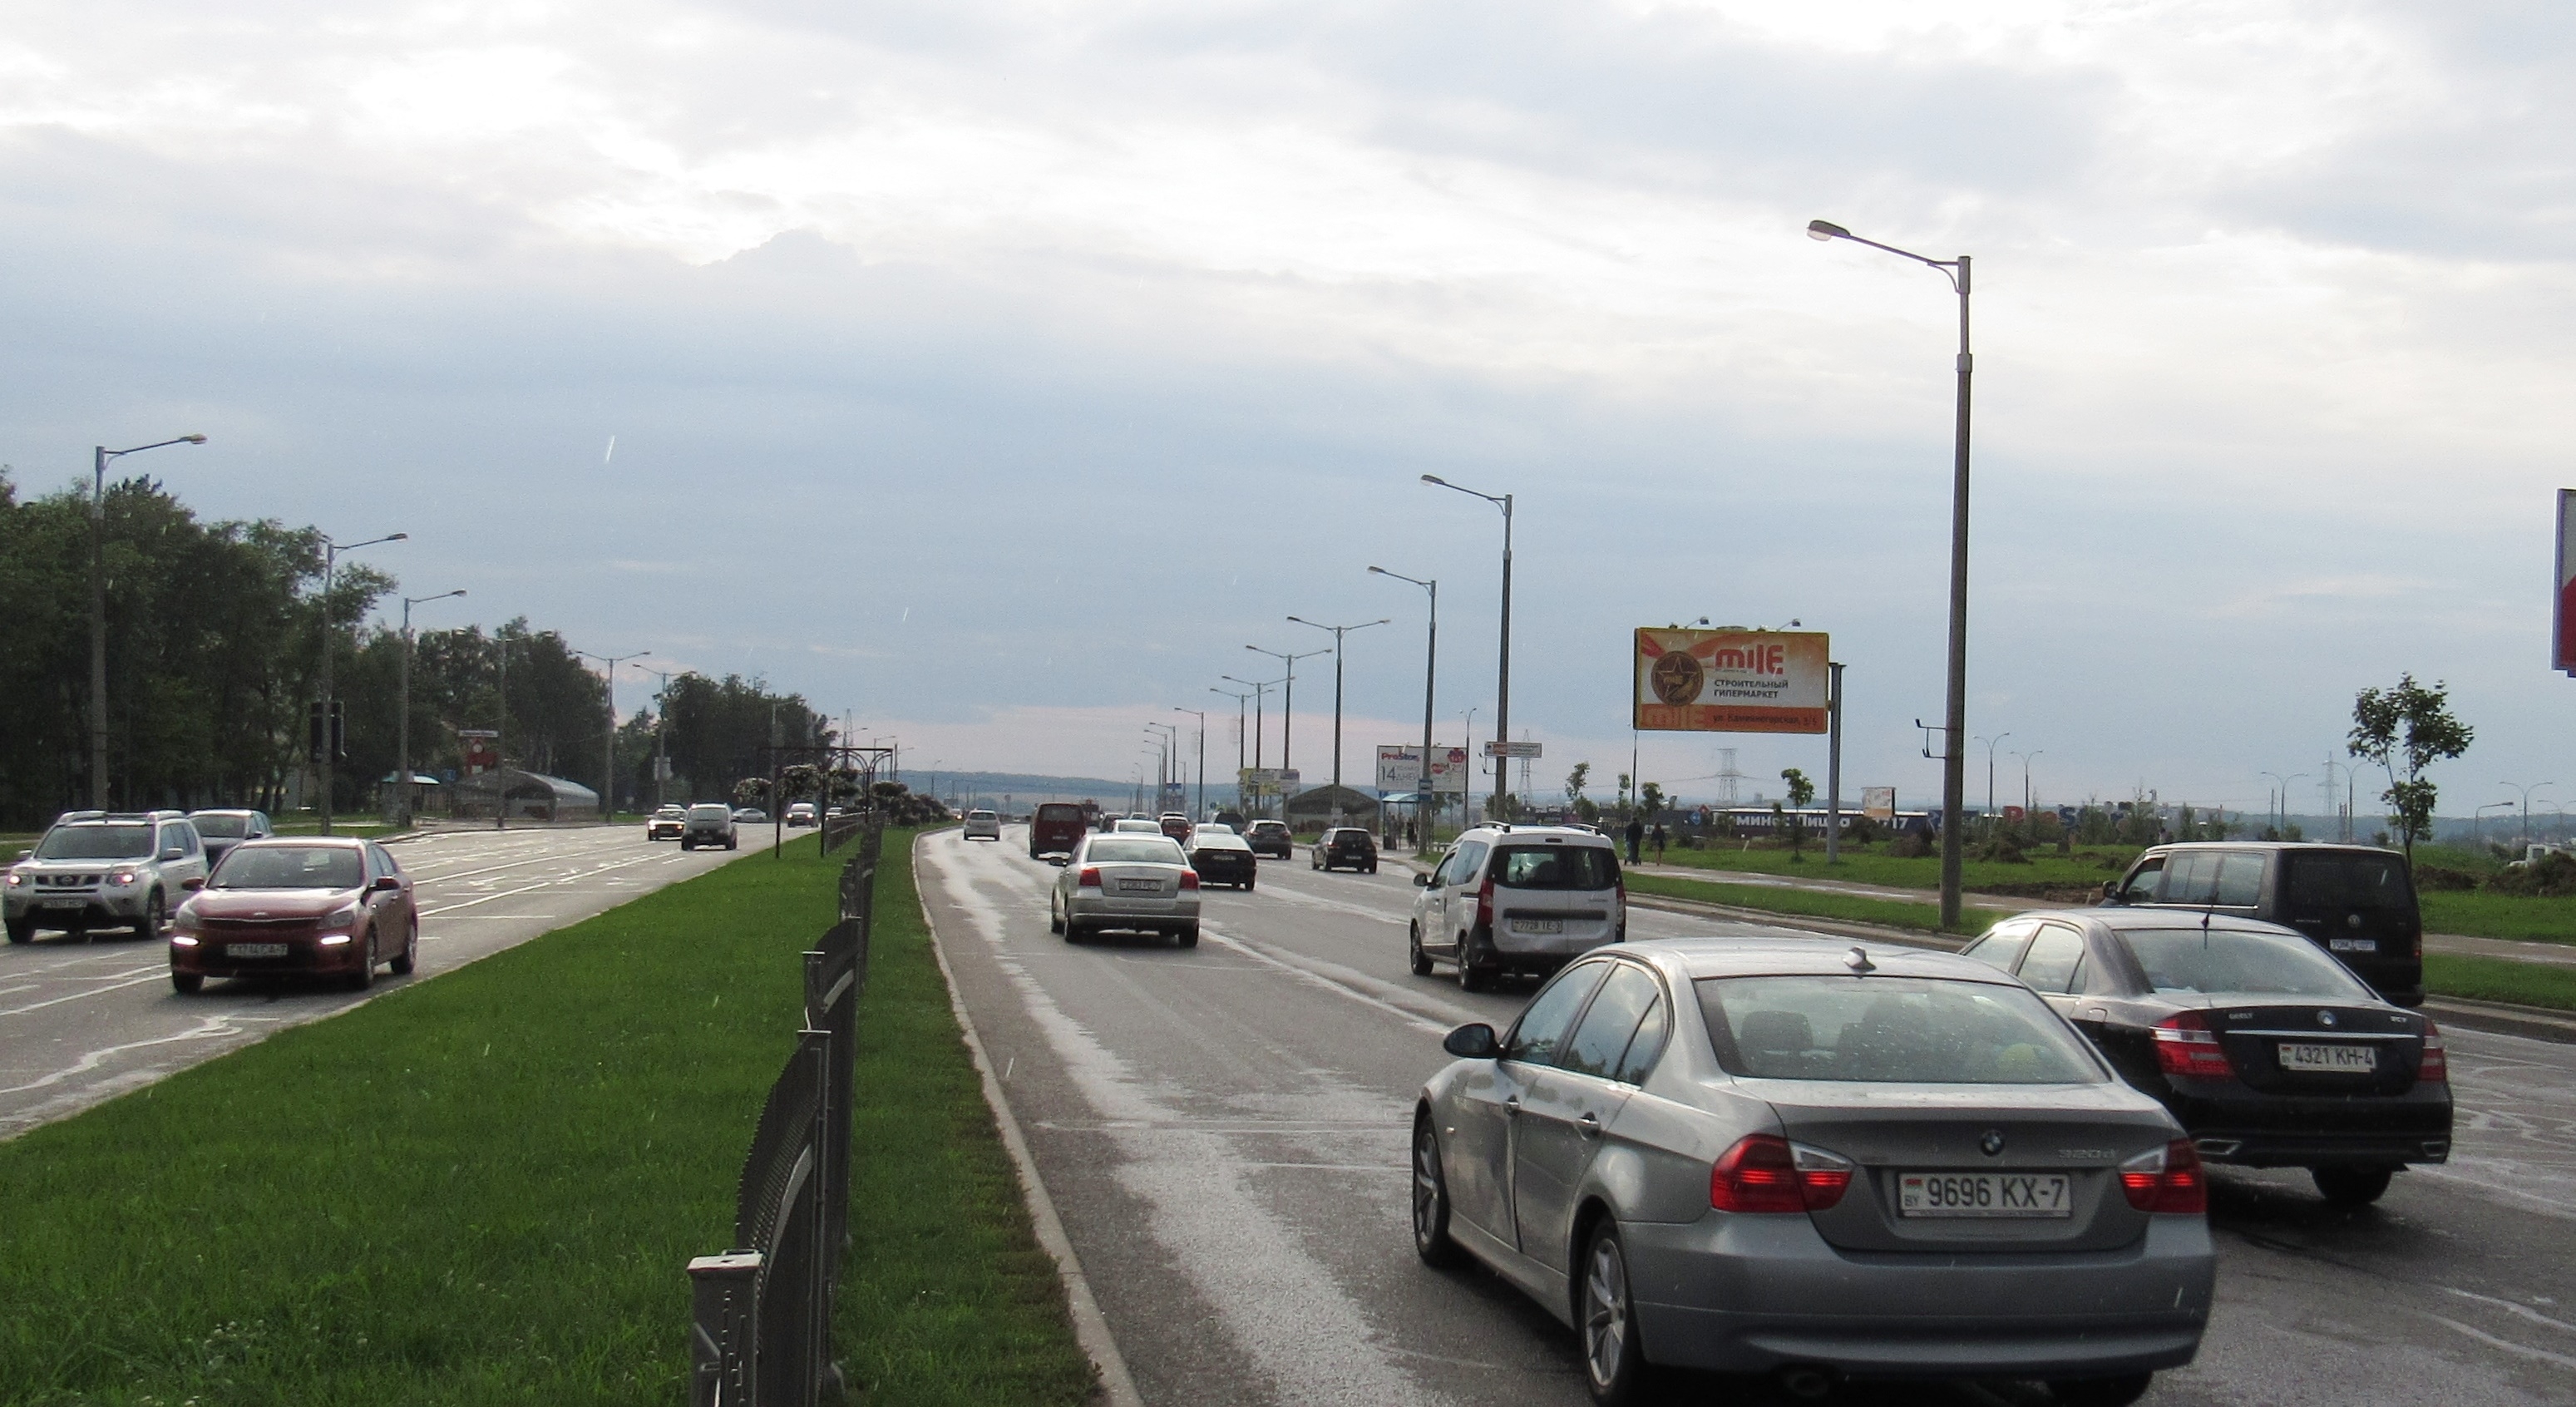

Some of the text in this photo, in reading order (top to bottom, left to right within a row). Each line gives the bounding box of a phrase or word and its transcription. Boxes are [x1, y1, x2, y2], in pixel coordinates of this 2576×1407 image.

[1714, 679, 1789, 689] СТРОИТЕЛЬНЫЙ
[1714, 689, 1779, 699] ГИПЕРМАРКЕТ
[2295, 1046, 2329, 1064] 4321
[1927, 1177, 1991, 1207] 9696
[2001, 1177, 2065, 1207] KX-7
